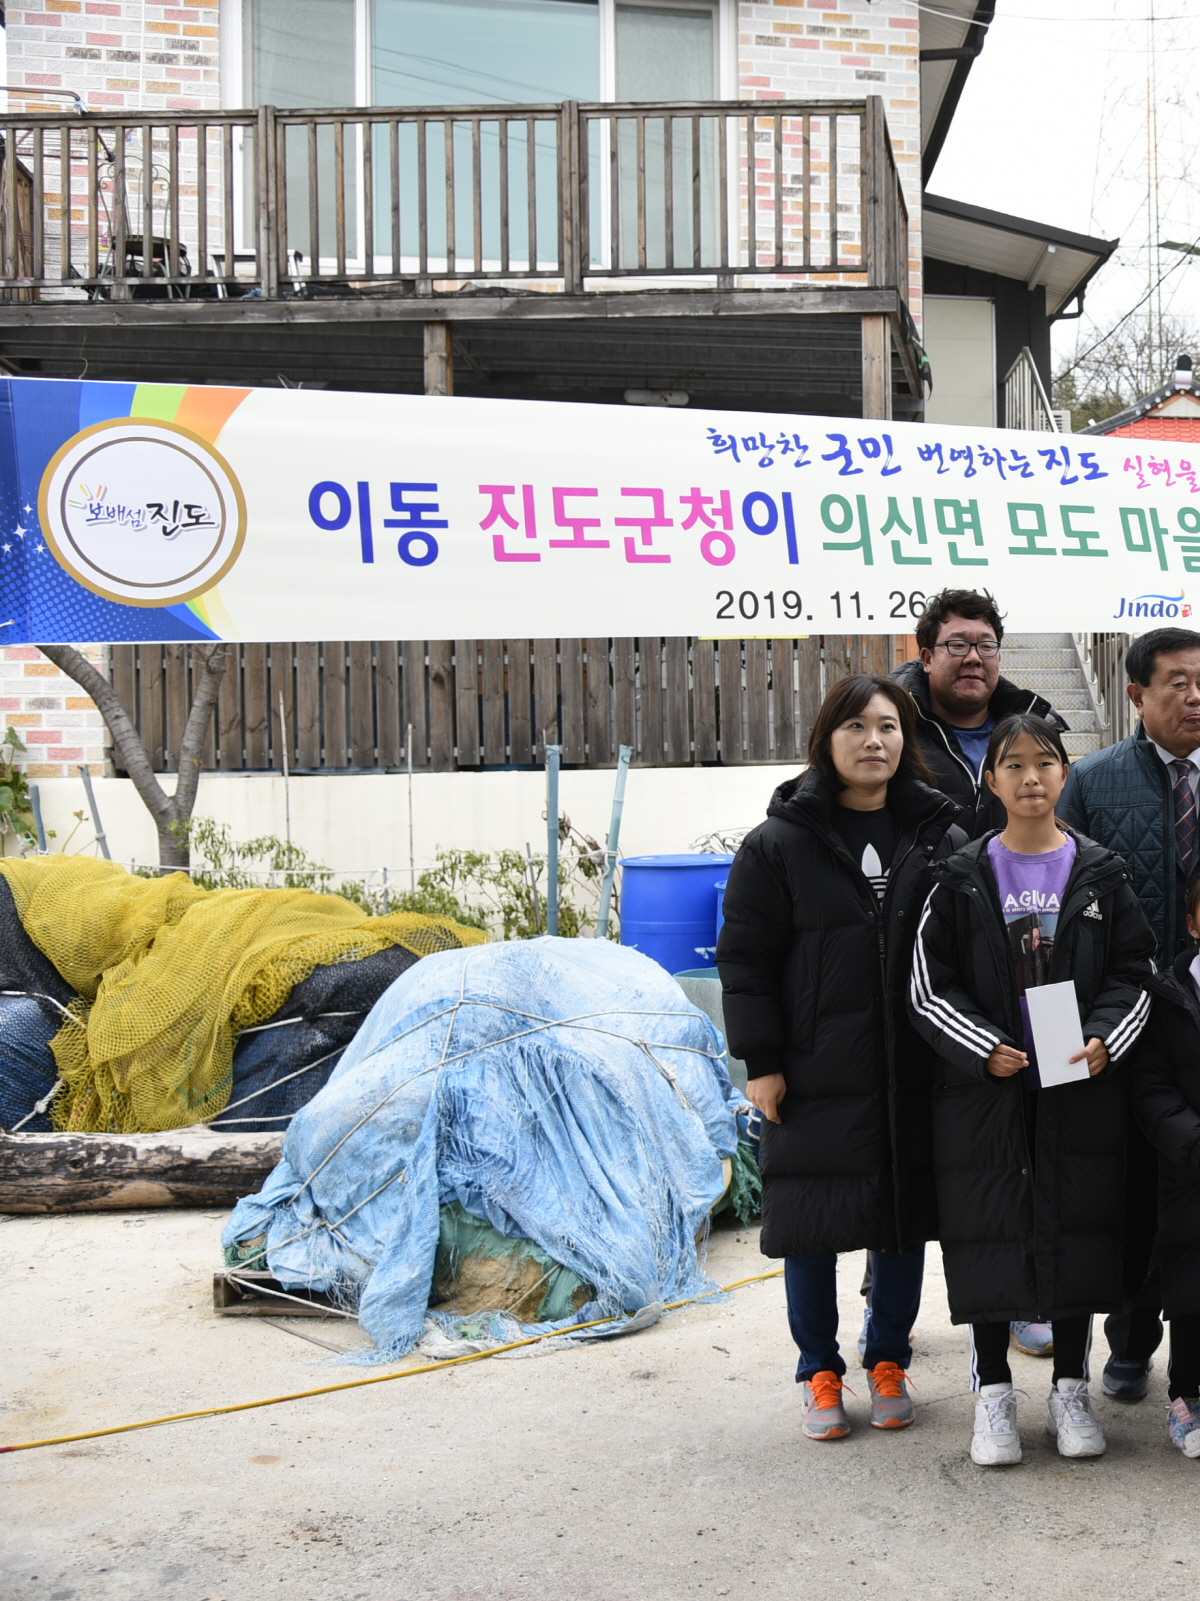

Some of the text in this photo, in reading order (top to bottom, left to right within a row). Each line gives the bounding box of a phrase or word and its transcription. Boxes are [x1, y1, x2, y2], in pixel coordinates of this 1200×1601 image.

[707, 428, 812, 468] 희망찬
[821, 433, 902, 477] 군민
[917, 443, 1035, 481] 번영하는
[1037, 445, 1109, 485] 진도
[86, 500, 216, 537] 보배섬 진도
[308, 480, 450, 567] 이동
[479, 484, 799, 566] 진도군청이
[820, 494, 989, 566] 의신면
[1008, 502, 1109, 557] 모도
[716, 590, 813, 621] 2019.
[830, 590, 874, 621] 11.
[1113, 597, 1179, 619] Jindo
